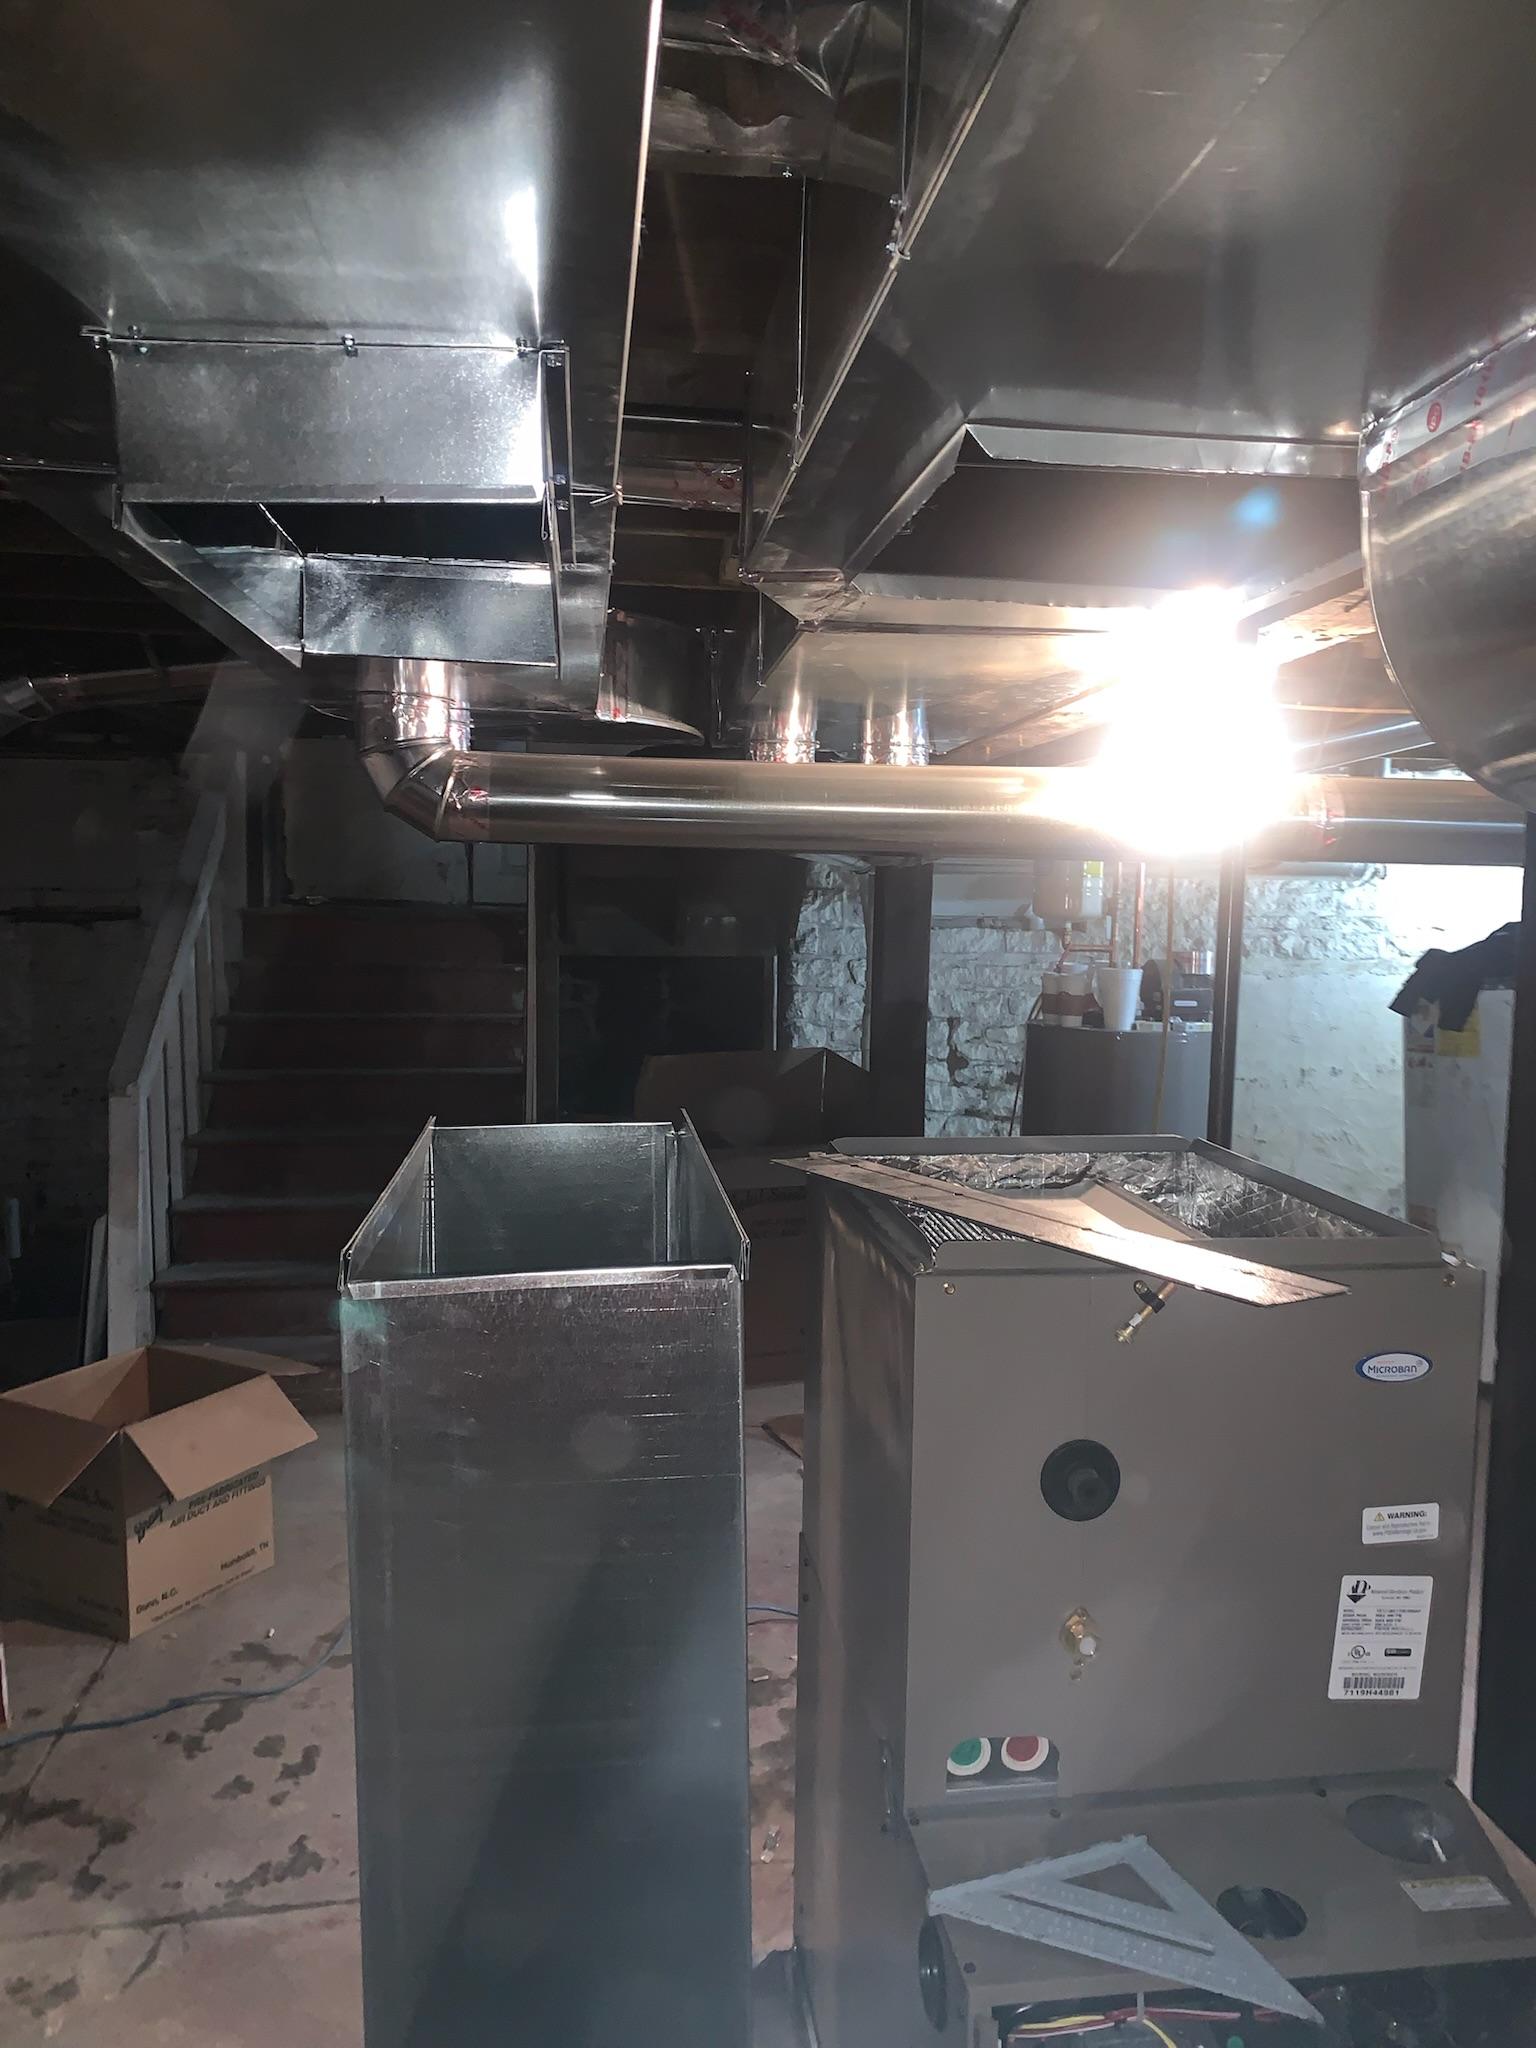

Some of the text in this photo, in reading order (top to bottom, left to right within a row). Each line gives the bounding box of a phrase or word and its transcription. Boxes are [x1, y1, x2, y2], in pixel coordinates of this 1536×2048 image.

[186, 1503, 212, 1522] DUCT
[212, 1494, 231, 1509] AND
[231, 1478, 266, 1499] FITTINGS
